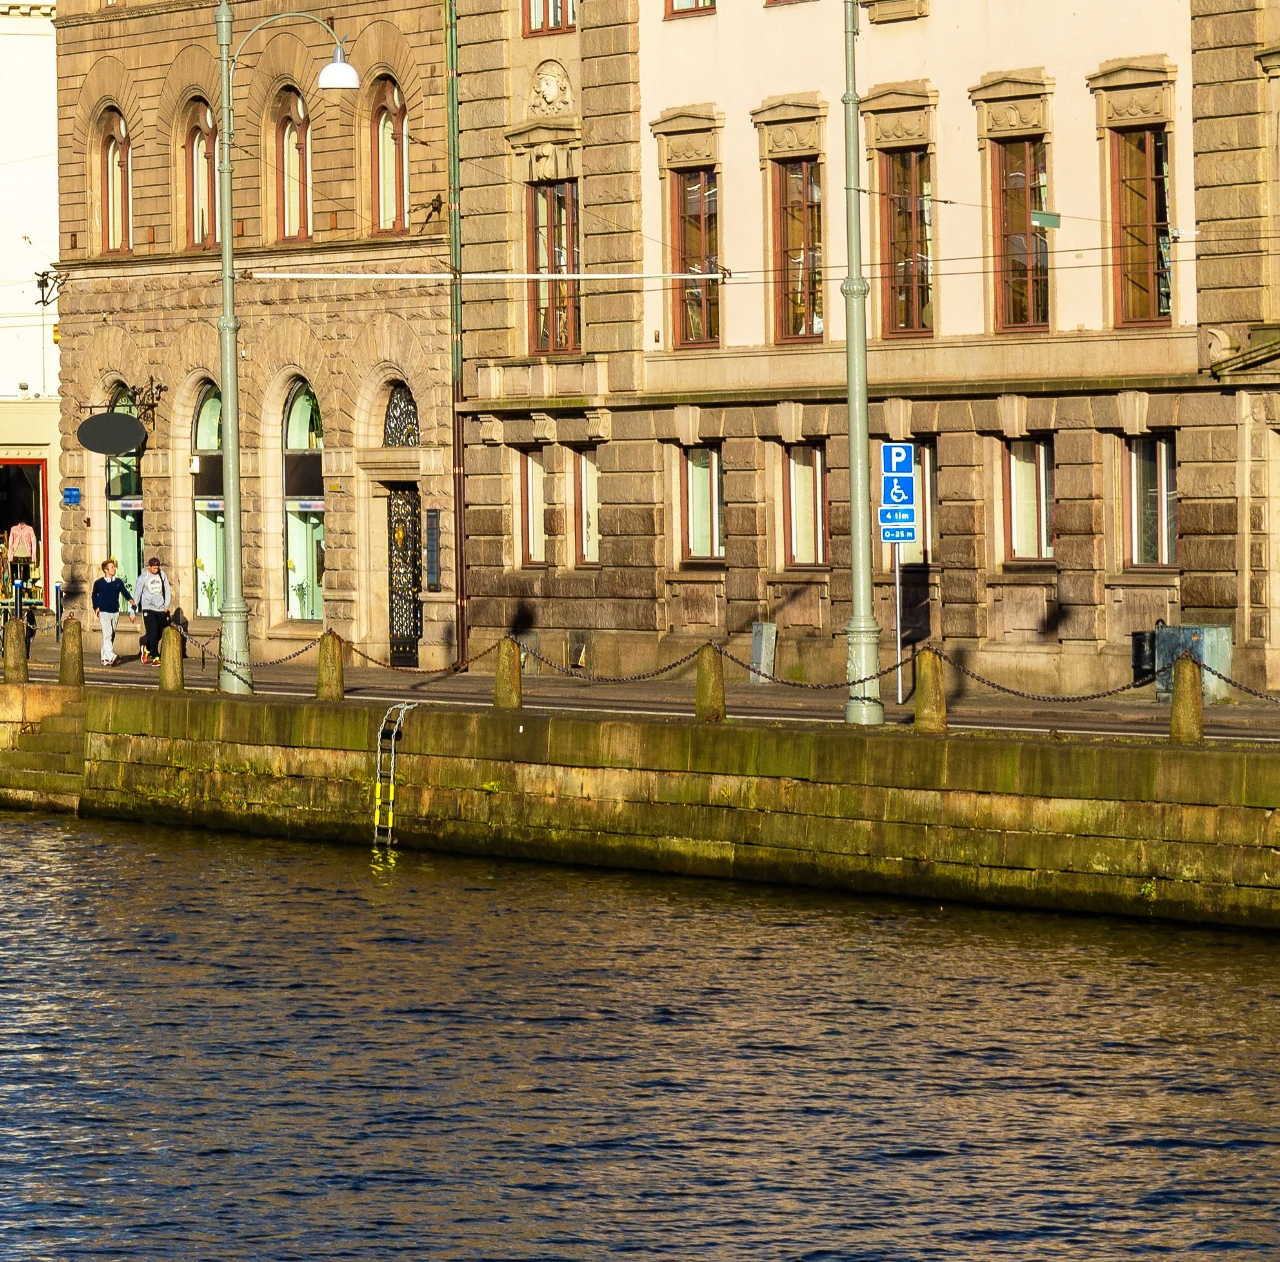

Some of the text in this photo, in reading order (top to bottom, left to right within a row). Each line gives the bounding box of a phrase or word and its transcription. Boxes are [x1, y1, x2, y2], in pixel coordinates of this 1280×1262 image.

[891, 446, 907, 472] P
[885, 511, 909, 520] 4 tim
